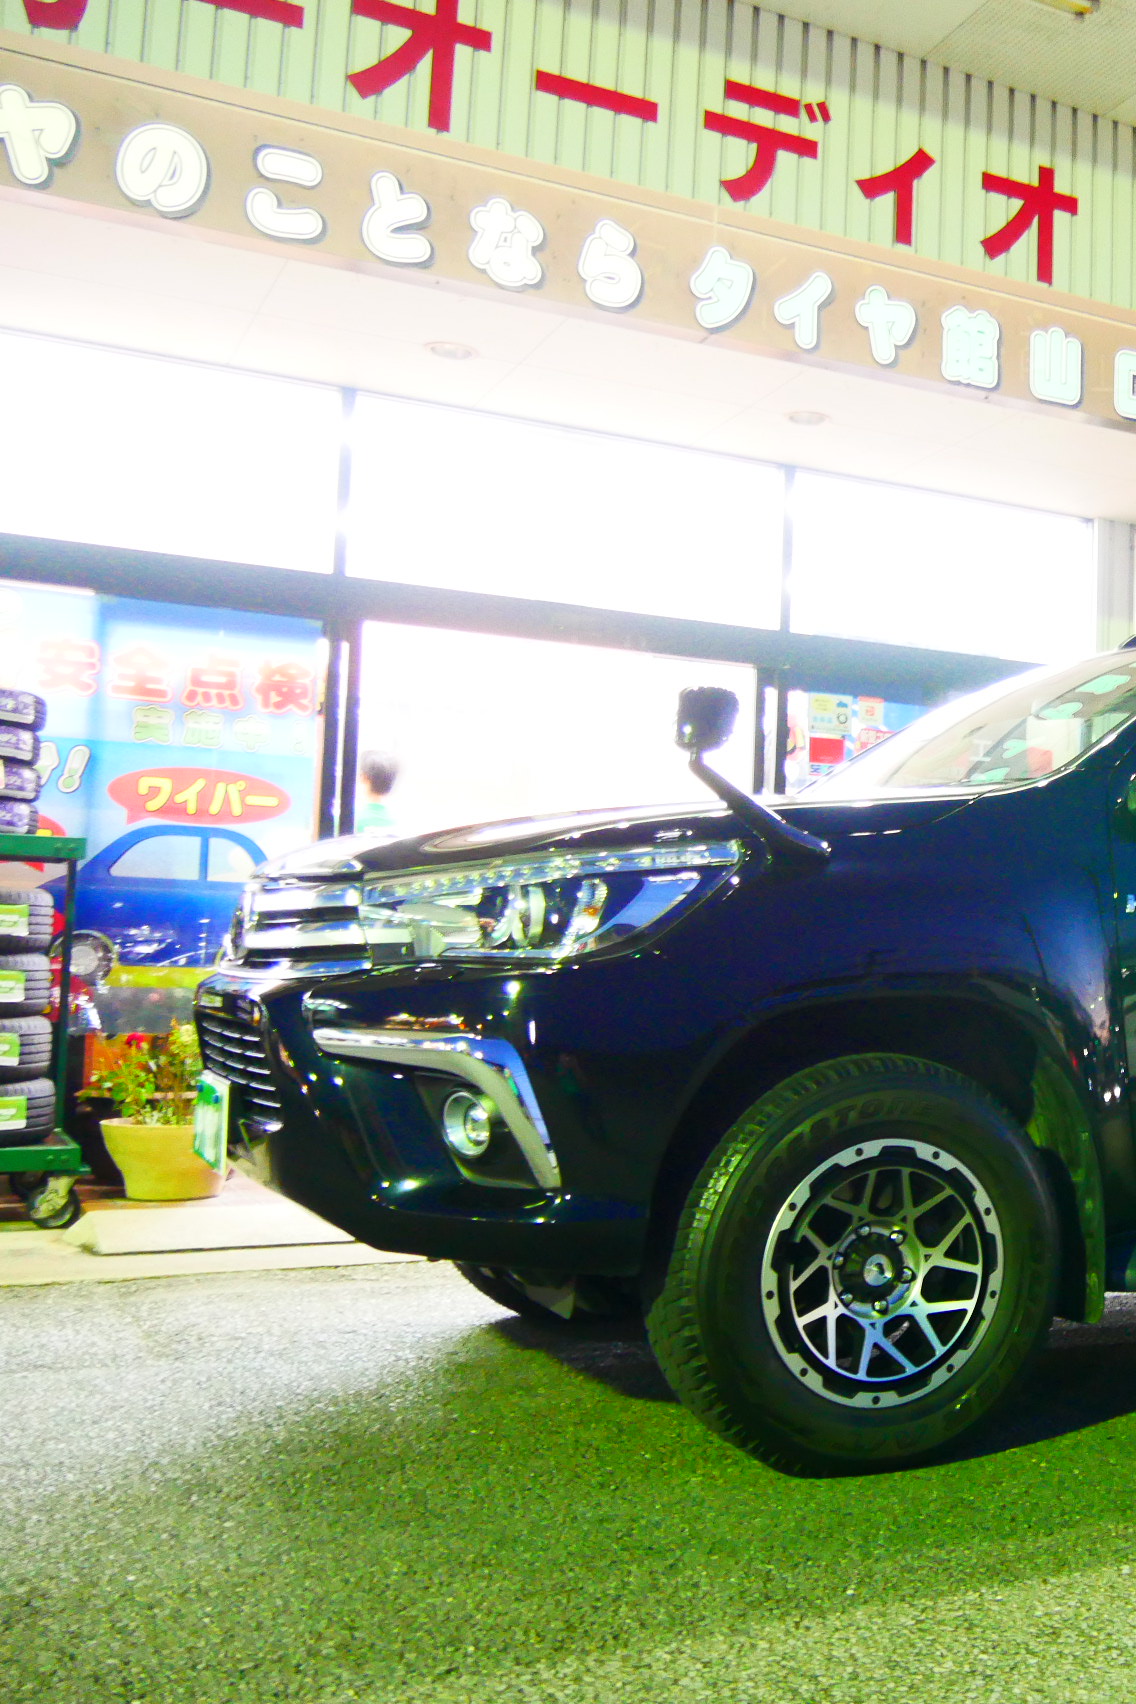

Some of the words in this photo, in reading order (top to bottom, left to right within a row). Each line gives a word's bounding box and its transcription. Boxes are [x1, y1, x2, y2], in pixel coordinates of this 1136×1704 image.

[39, 638, 316, 715] 安全点検
[137, 776, 280, 817] ワイパー
